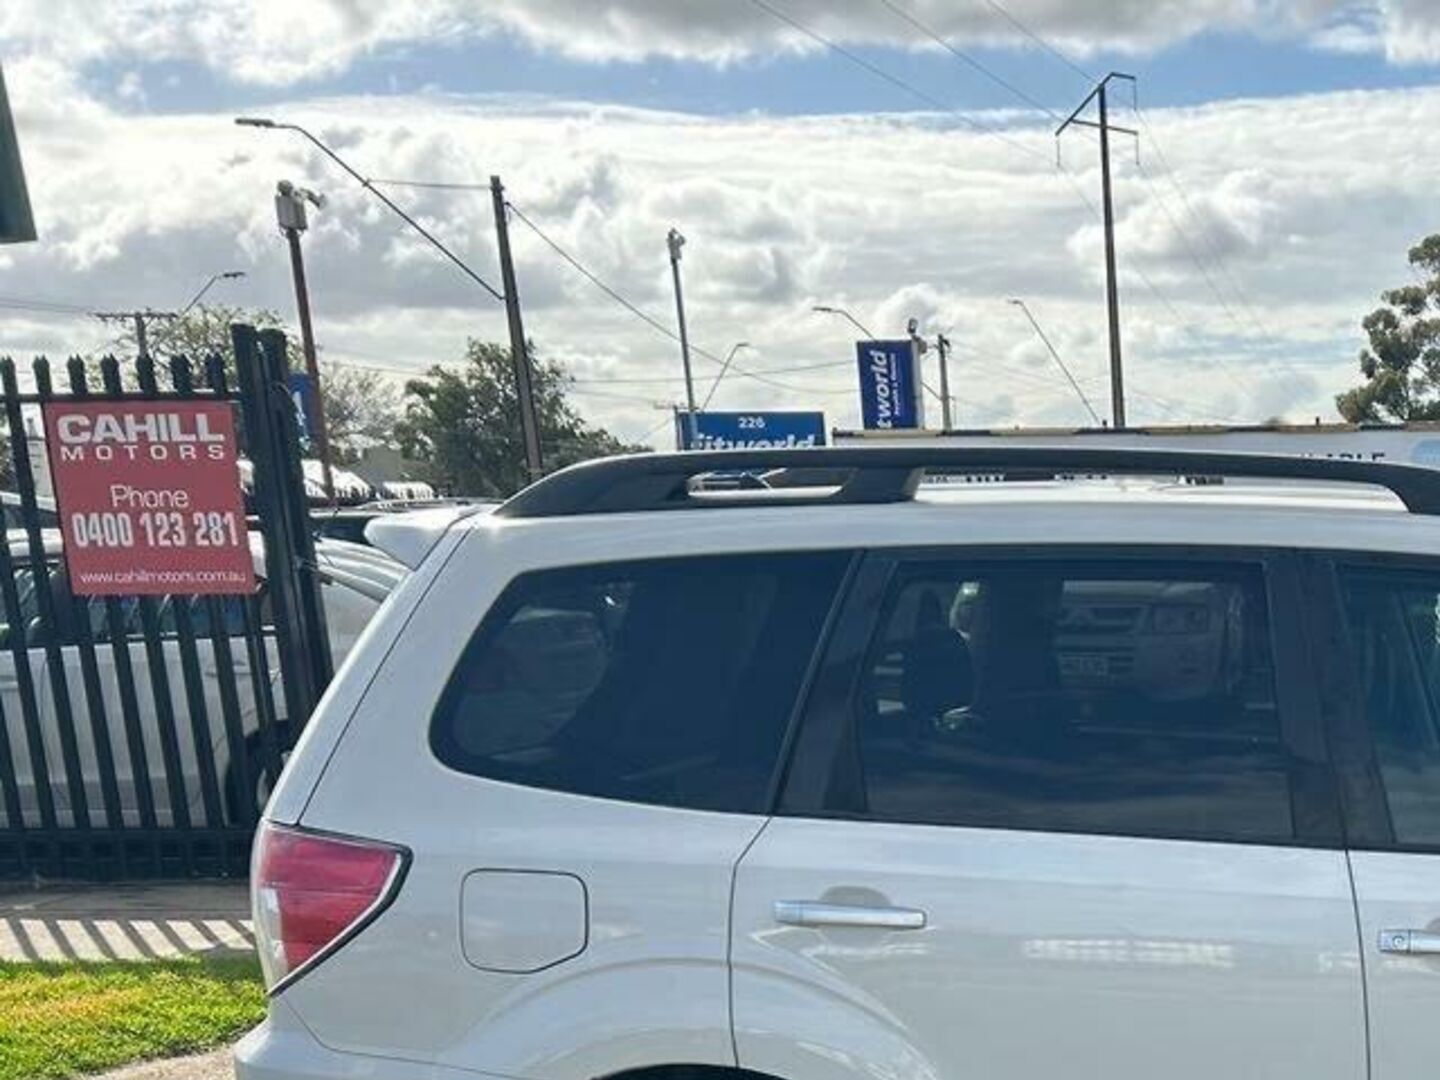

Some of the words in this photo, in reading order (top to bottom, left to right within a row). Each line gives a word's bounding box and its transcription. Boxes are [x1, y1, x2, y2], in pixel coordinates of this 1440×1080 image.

[56, 413, 226, 444] CAHILL
[737, 416, 766, 430] 226
[60, 445, 226, 461] MOTORS
[110, 484, 189, 509] Phone
[71, 512, 135, 548] 0400
[139, 512, 187, 548] 123
[193, 512, 239, 547] 281
[79, 568, 247, 584] www.cahillmotors.com.au
